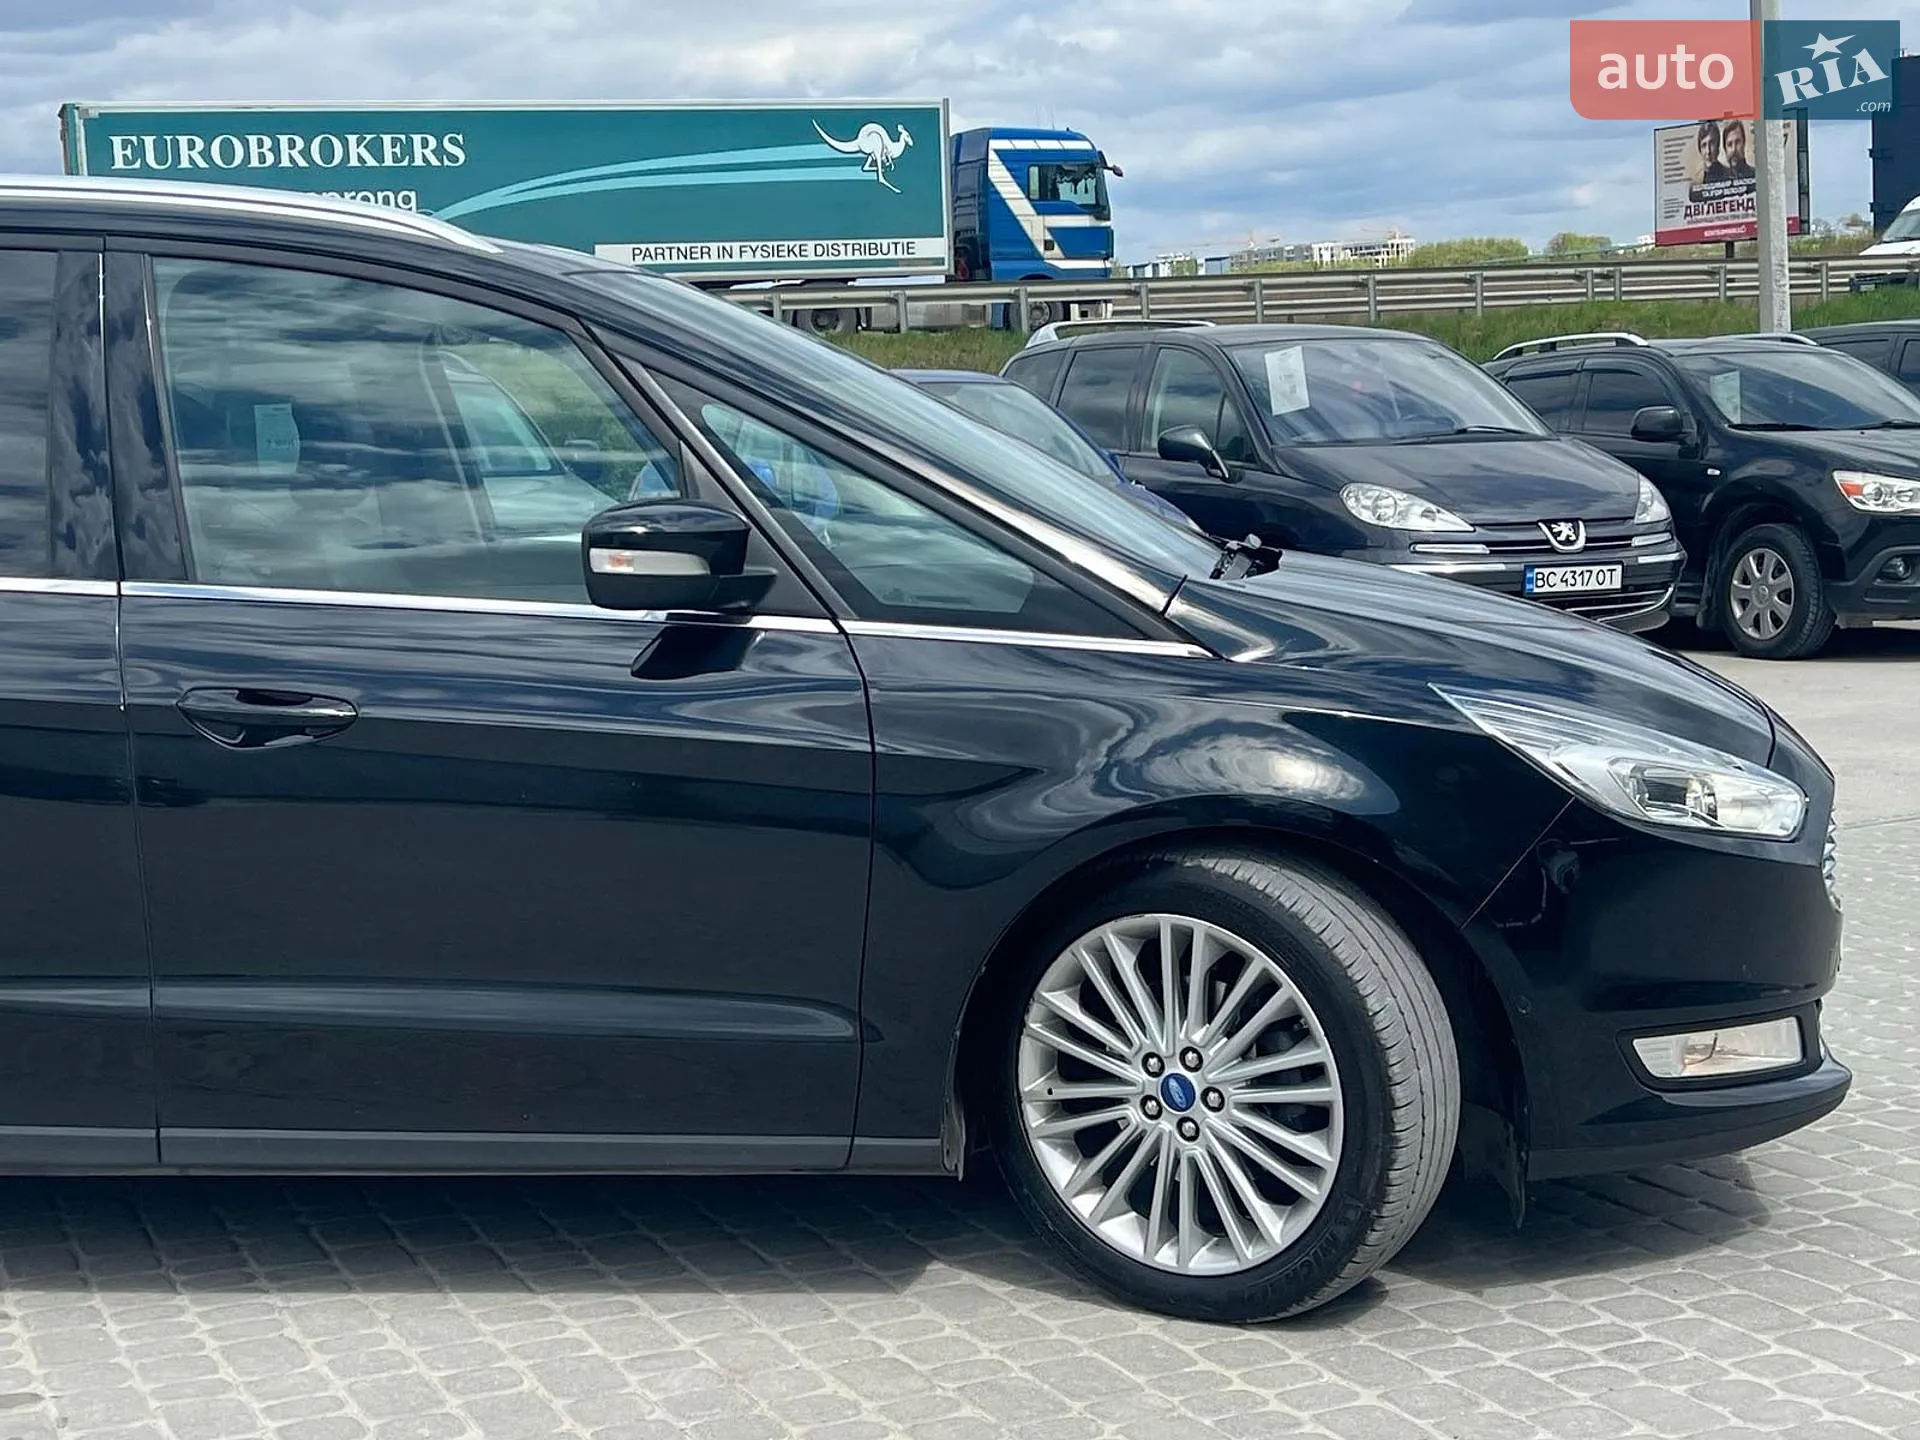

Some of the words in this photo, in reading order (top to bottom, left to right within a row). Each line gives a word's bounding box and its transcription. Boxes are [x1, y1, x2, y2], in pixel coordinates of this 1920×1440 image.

[109, 133, 467, 170] EUROBROKERS
[1684, 204, 1704, 220] ДВІ
[1706, 198, 1756, 215] ЛЕГЕНД
[631, 246, 712, 262] PARTNER
[717, 245, 734, 260] IN
[739, 243, 809, 259] FYSIEKE
[814, 241, 917, 257] DISTRIBUTIE
[1535, 571, 1557, 588] BC
[1560, 569, 1593, 587] 4317
